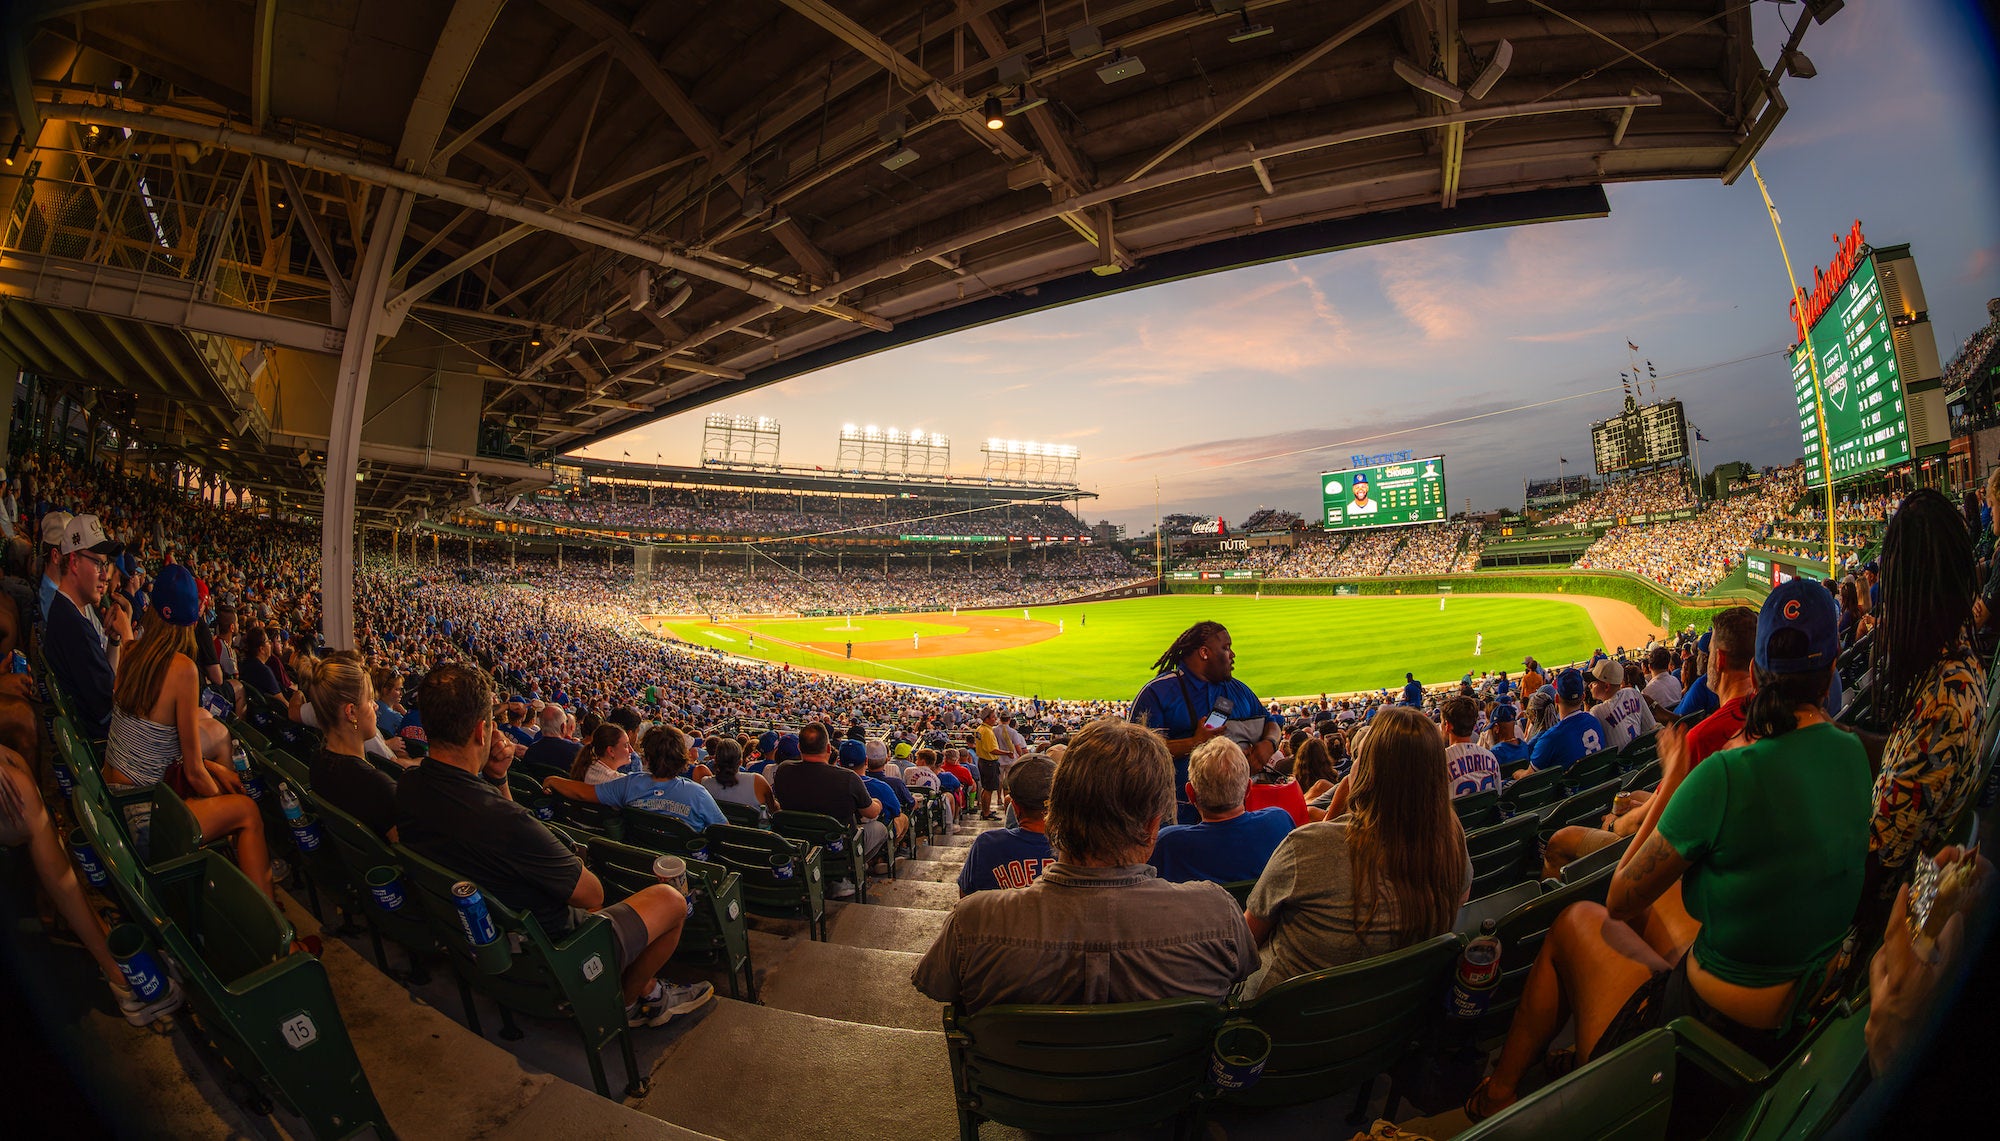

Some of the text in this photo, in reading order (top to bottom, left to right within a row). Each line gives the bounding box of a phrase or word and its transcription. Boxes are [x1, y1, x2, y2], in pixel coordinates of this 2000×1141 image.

[1789, 218, 1864, 343] Budweiser
[1351, 449, 1413, 468] WINTRUST
[162, 606, 172, 618] C
[1784, 600, 1800, 620] C
[1605, 698, 1640, 728] WILSON
[1448, 754, 1499, 780] ENDRICK
[587, 961, 599, 975] 14
[289, 1020, 310, 1040] 15
